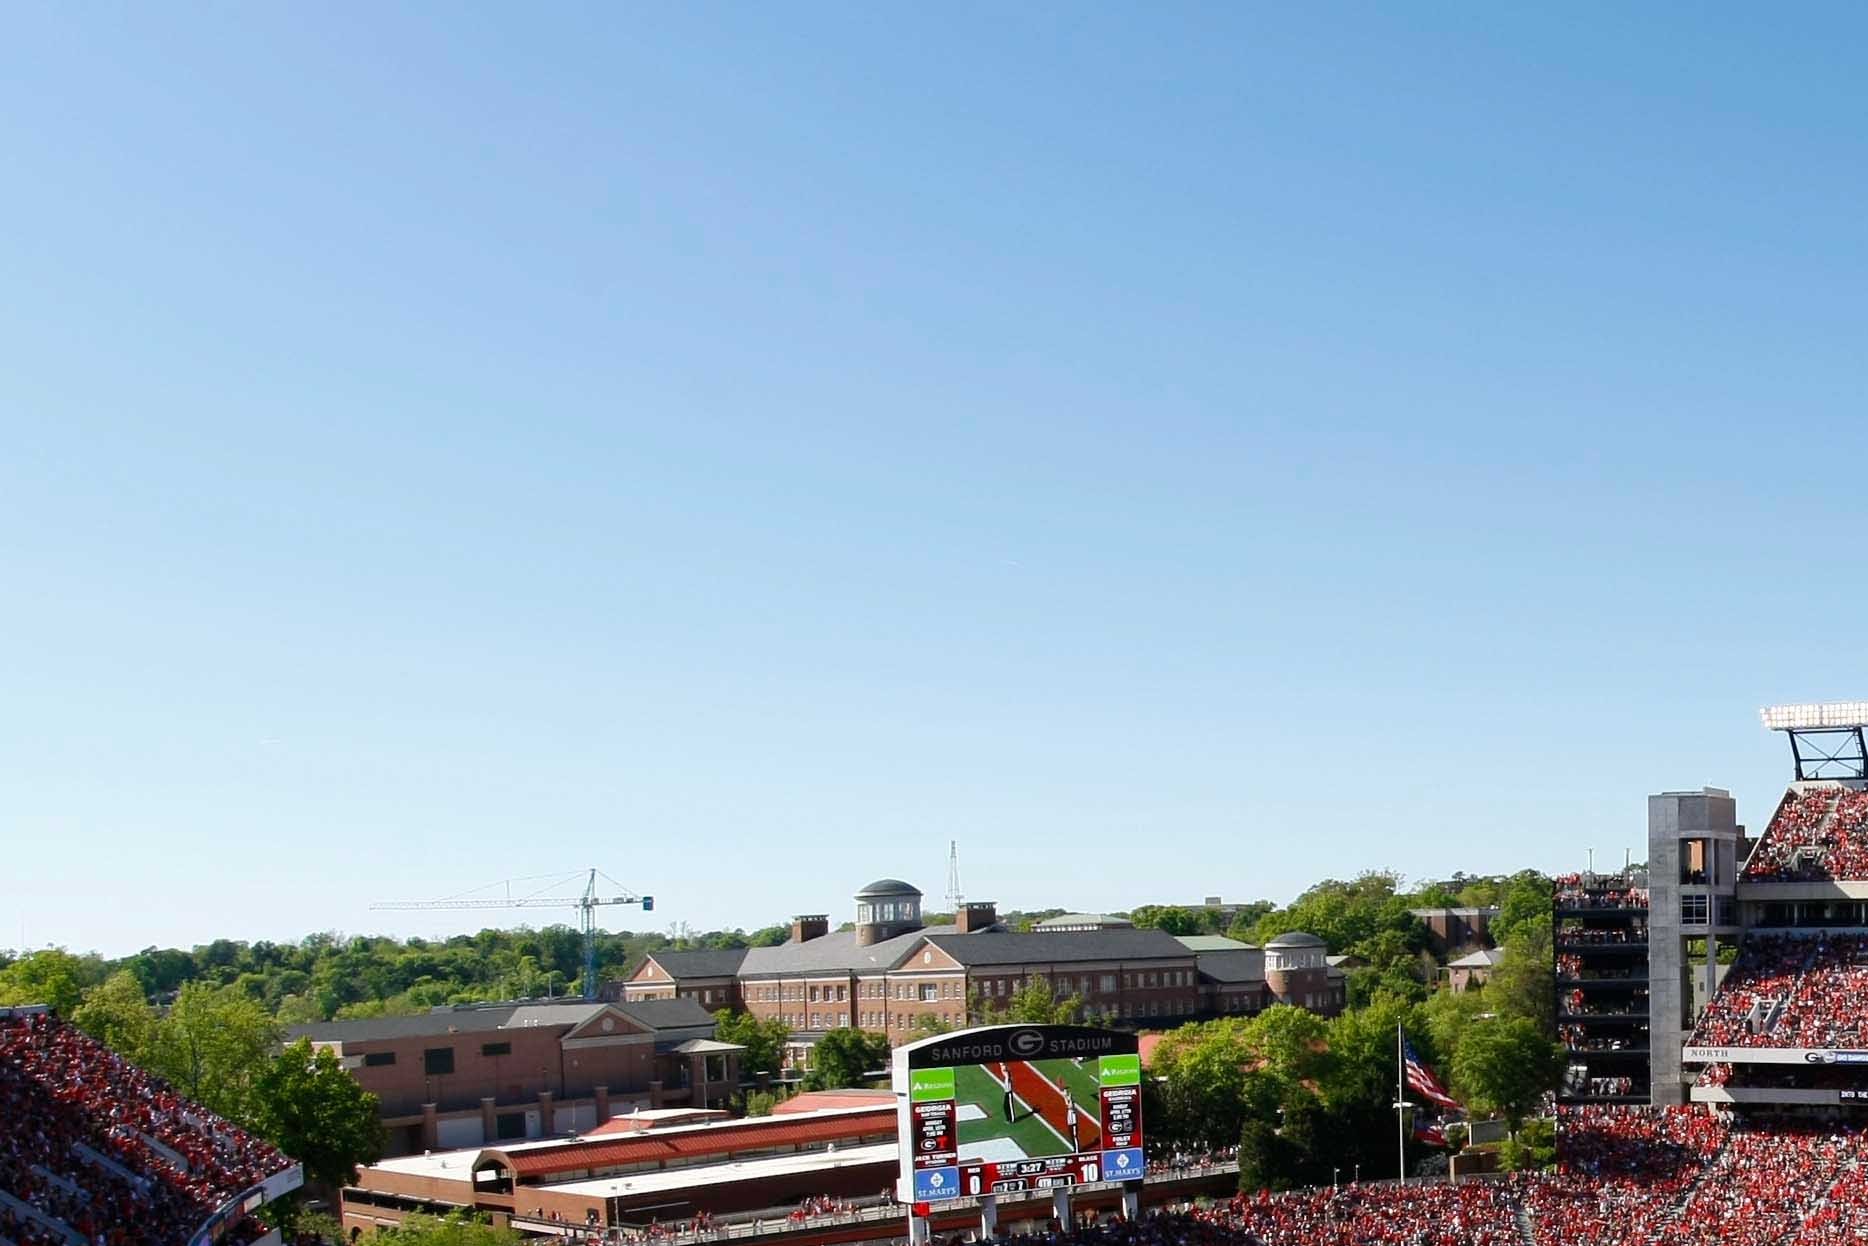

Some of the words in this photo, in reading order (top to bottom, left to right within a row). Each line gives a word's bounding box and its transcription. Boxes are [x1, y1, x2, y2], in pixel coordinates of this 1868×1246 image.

[932, 1044, 1001, 1060] SANFORD
[1050, 1037, 1112, 1052] STADIUM
[1021, 1163, 1042, 1174] 3:27
[1081, 1164, 1098, 1182] 10
[970, 1176, 980, 1194] 0
